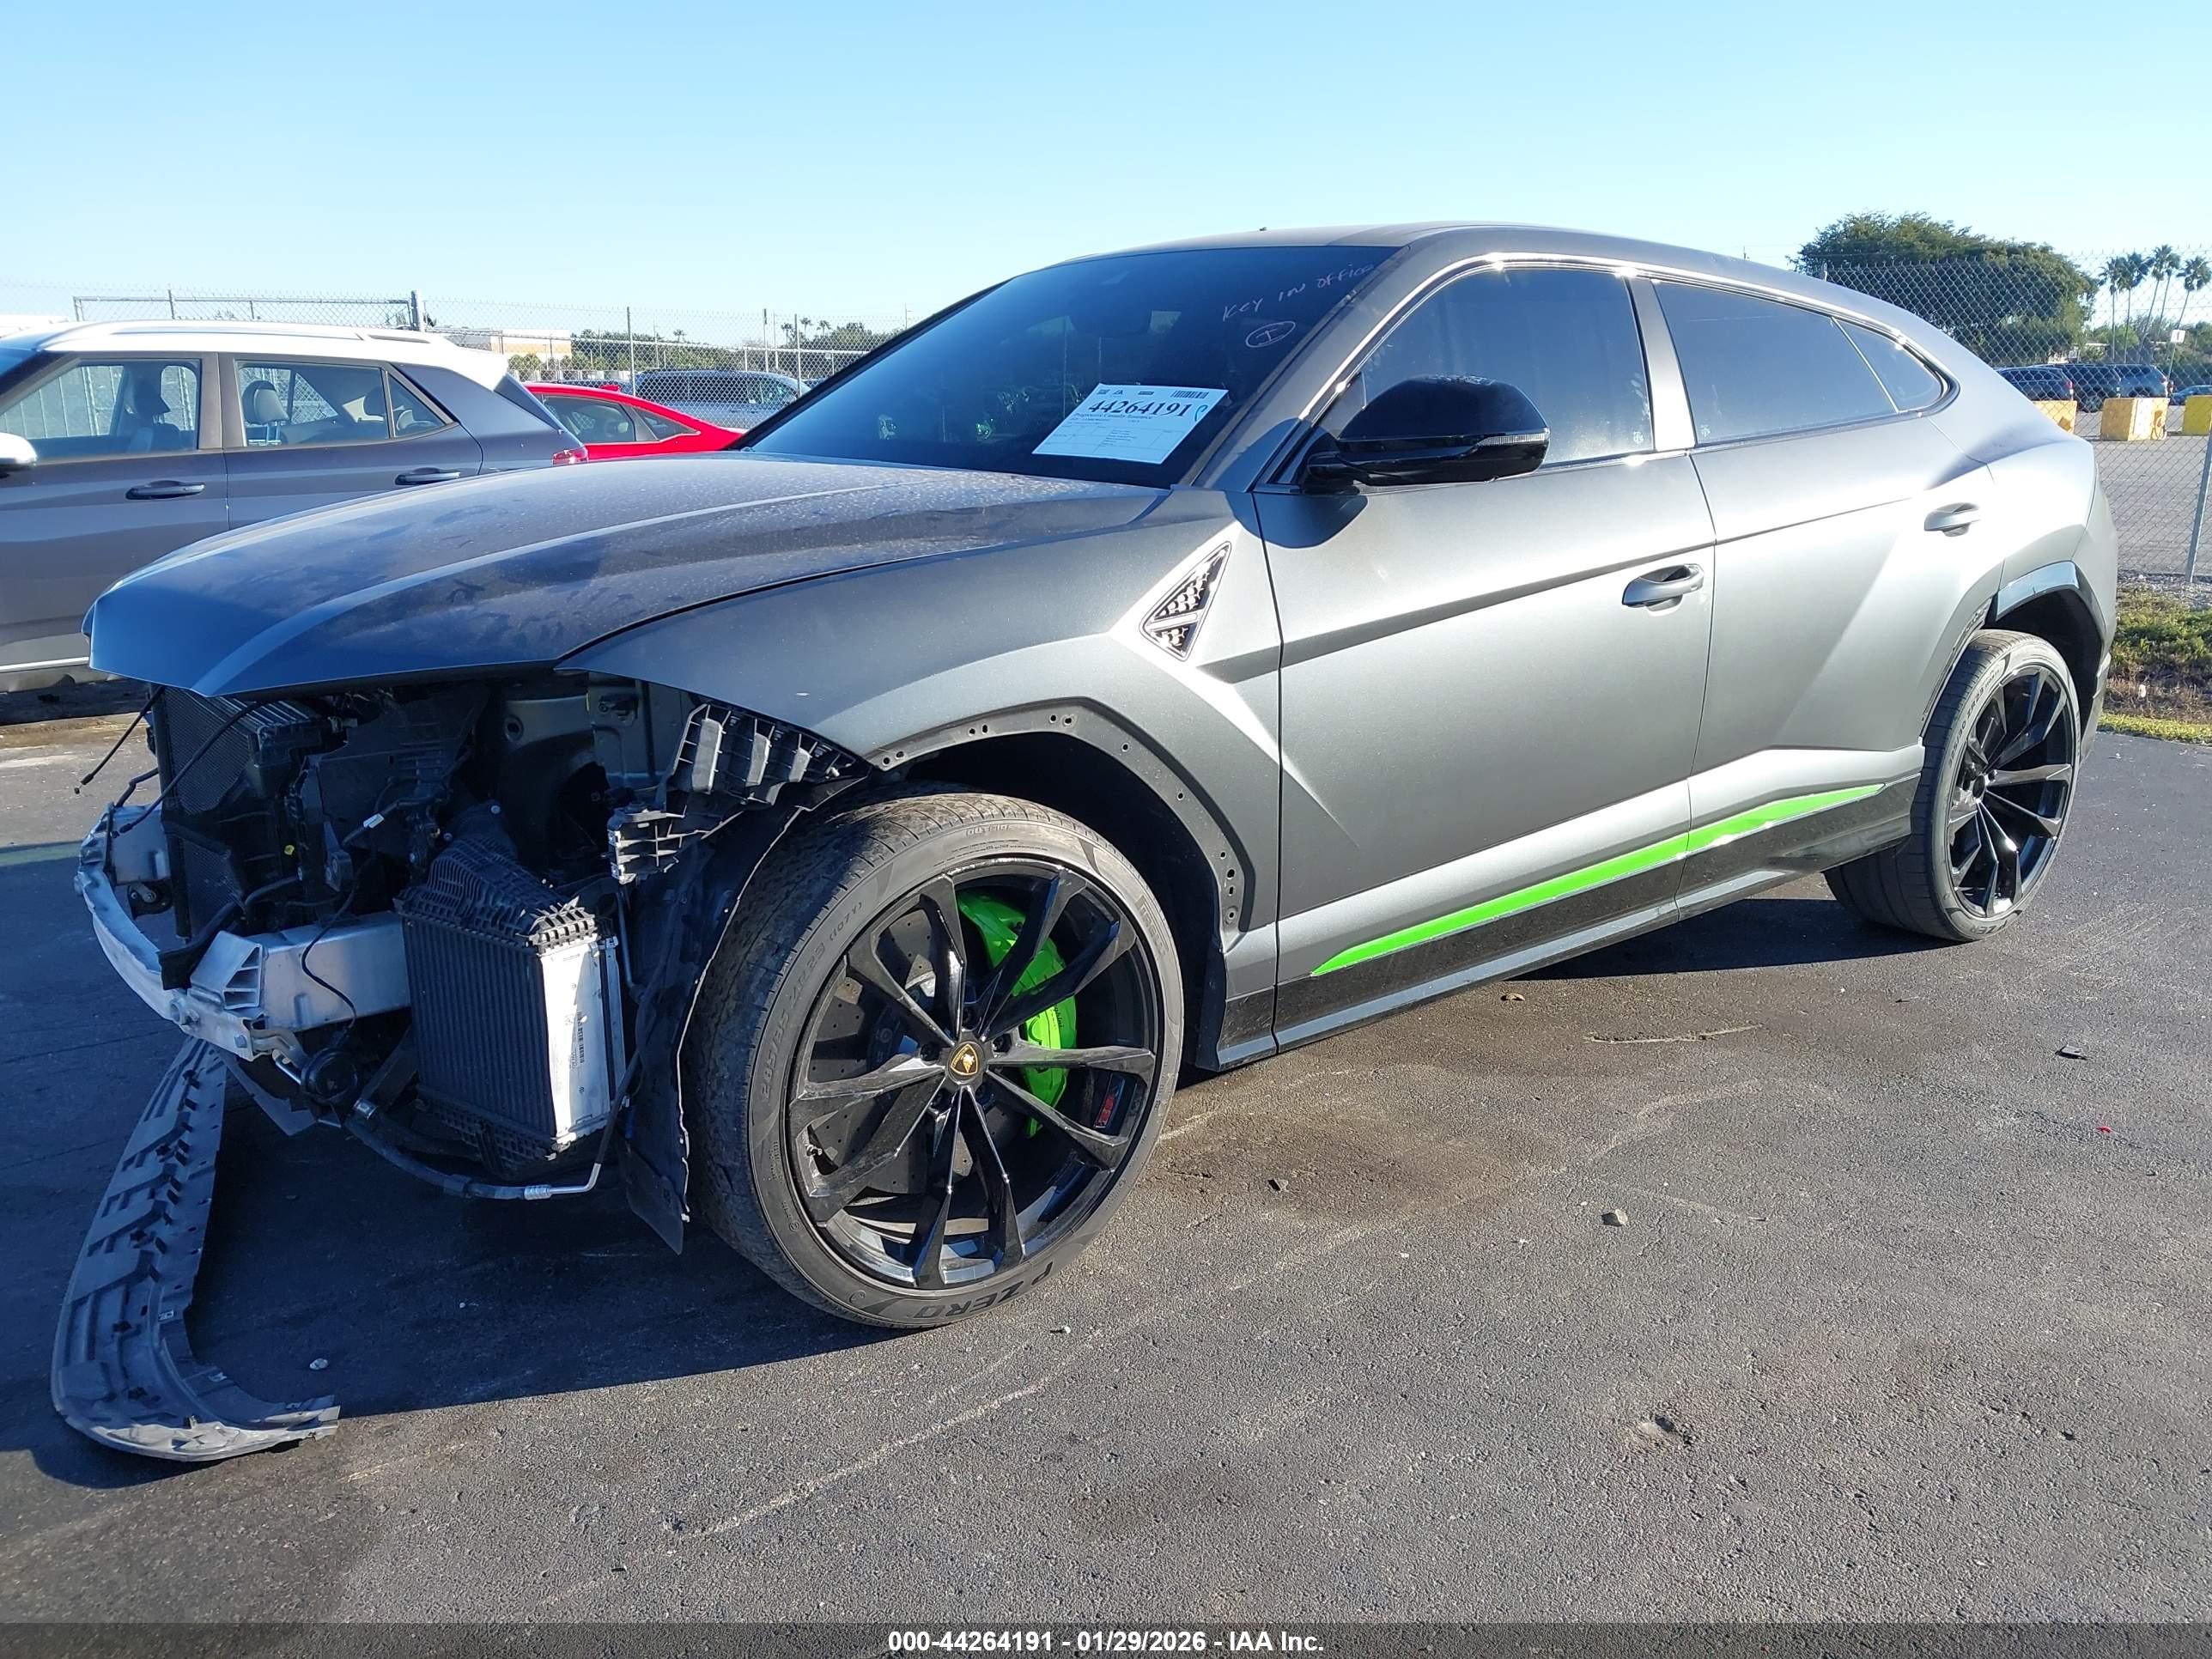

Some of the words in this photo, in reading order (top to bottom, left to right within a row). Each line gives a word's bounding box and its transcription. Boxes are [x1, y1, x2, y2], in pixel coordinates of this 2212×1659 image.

[1222, 298, 1264, 323] KEY
[1278, 283, 1306, 302] IN
[1088, 399, 1193, 417] 44264191
[1031, 1261, 1054, 1285] P
[913, 1280, 1024, 1319] ZERO
